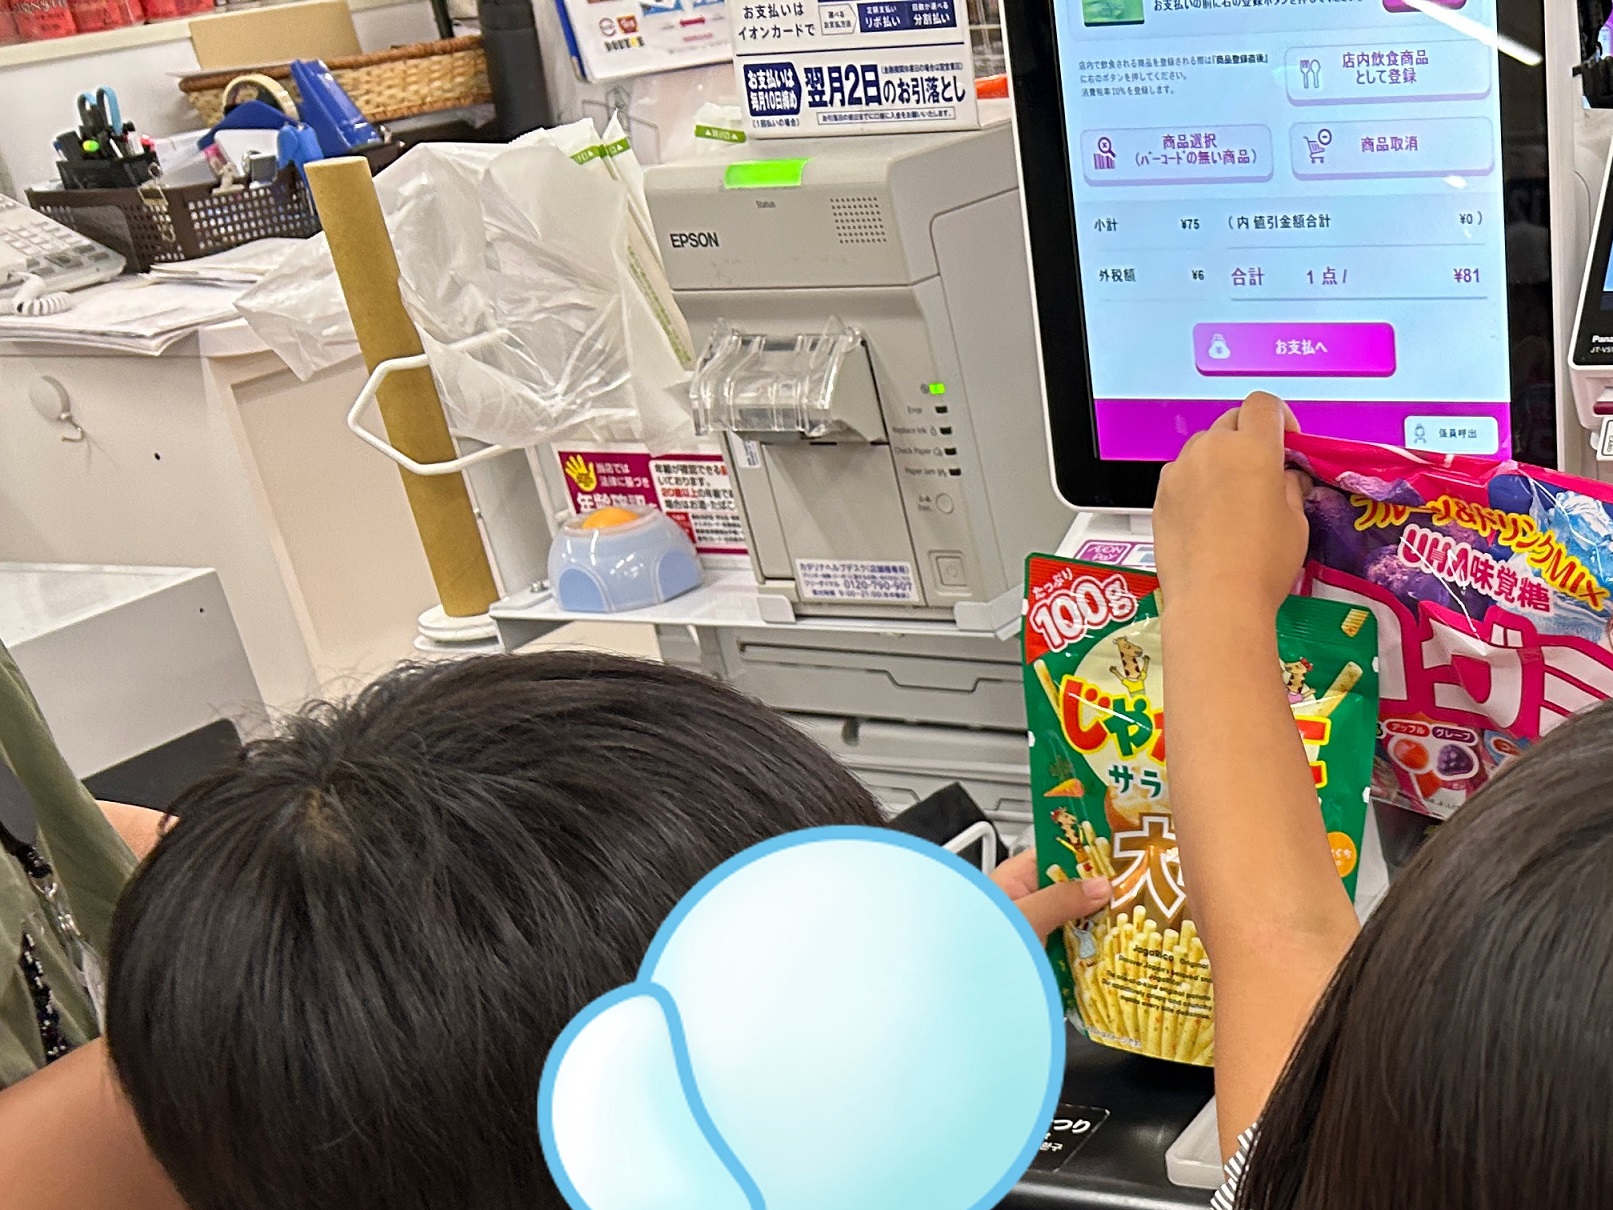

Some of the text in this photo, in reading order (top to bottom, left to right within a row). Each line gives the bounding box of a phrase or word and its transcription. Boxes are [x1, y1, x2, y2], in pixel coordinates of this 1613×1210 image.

[743, 3, 804, 20] お支払いは
[913, 14, 950, 26] 分割払い
[738, 23, 815, 41] イオンカードで
[1342, 50, 1429, 69] 店内飲食商品
[748, 68, 794, 88] お支払いは
[1356, 68, 1417, 85] として登録
[1163, 133, 1217, 150] 商品選択
[1361, 136, 1418, 153] 商品取消
[1094, 217, 1200, 231] 小計 ¥75
[1254, 214, 1331, 229] 値引金額合計
[670, 232, 719, 248] EPSON
[1099, 268, 1136, 283] 外税額
[1231, 267, 1265, 286] 合計
[1453, 268, 1480, 283] ¥81
[1275, 338, 1328, 356] お支払へ
[1439, 428, 1477, 439] 係員呼出
[1401, 525, 1552, 615] UHA味覚糖
[1032, 567, 1073, 600] たっぷり
[1053, 1119, 1091, 1134] つり
